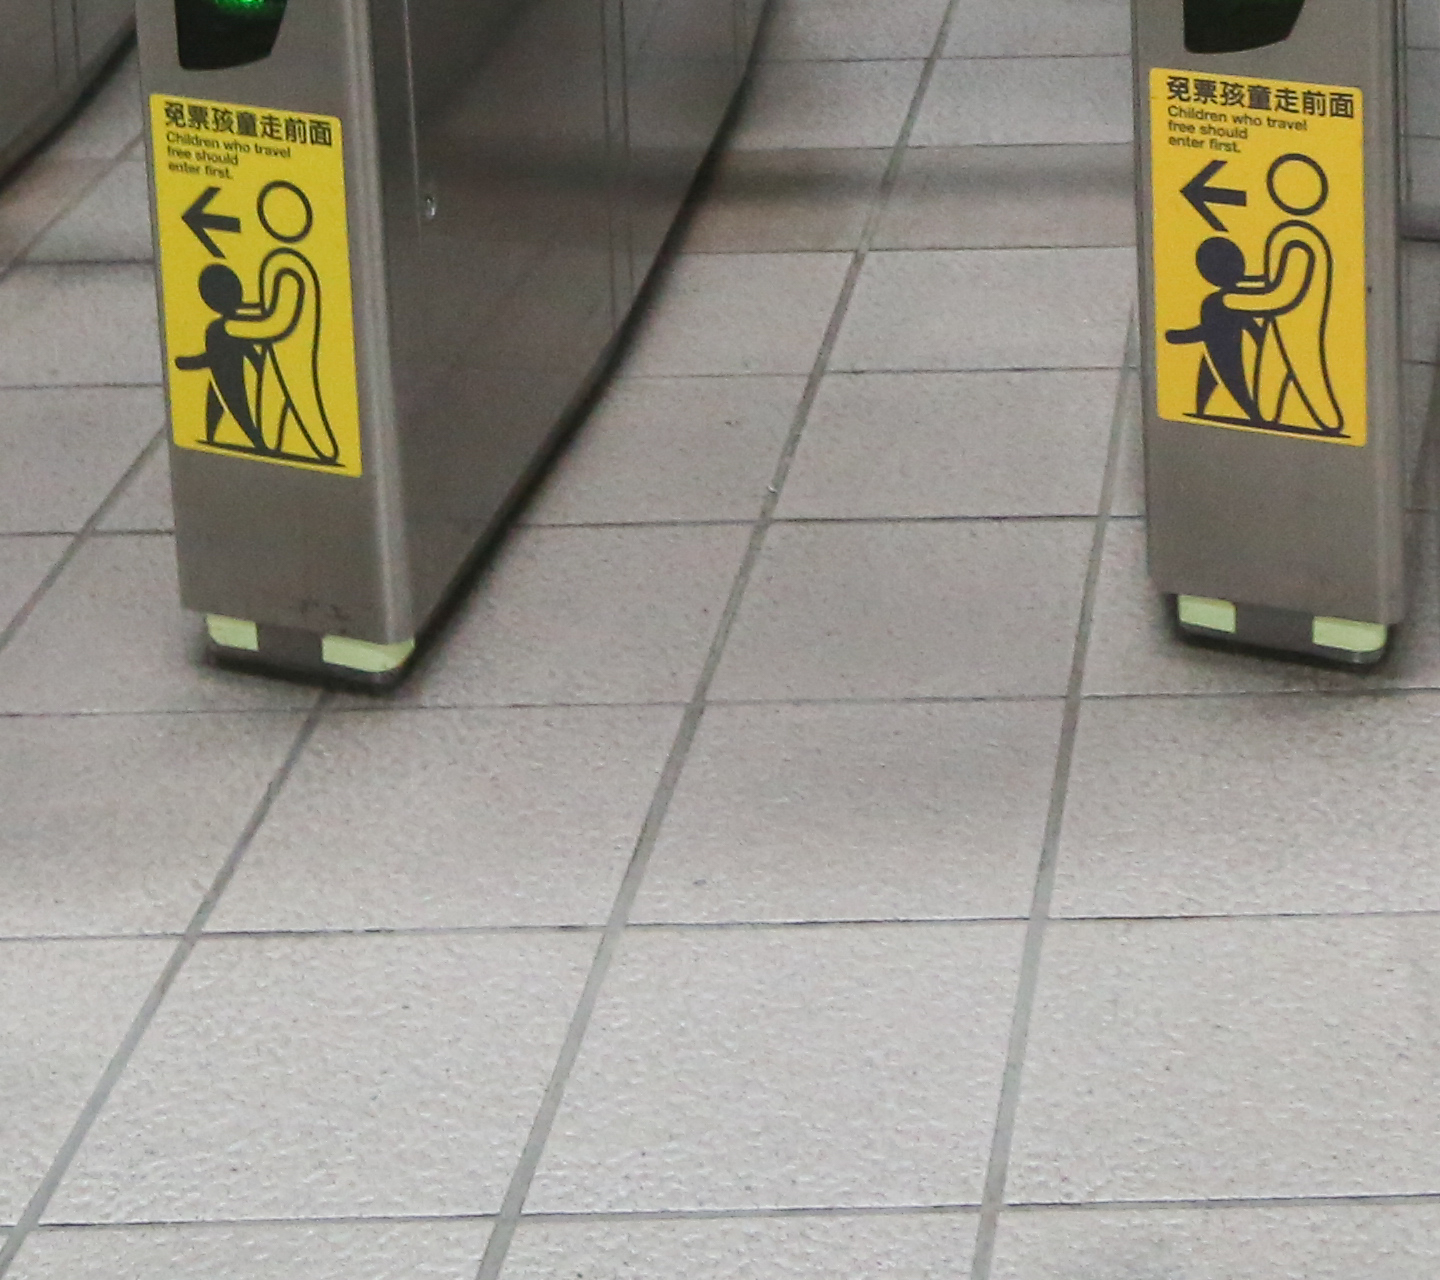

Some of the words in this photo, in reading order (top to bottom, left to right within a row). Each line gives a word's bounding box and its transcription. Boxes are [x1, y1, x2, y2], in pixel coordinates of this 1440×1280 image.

[1166, 76, 1354, 119] 免票孩童走前面
[164, 101, 332, 148] 免票孩童走前面
[1168, 105, 1226, 123] Children
[1232, 114, 1262, 127] who
[1267, 116, 1308, 131] travel
[1168, 120, 1196, 134] free
[1200, 123, 1248, 140] should
[166, 131, 220, 148] Children
[224, 140, 250, 153] who
[255, 143, 291, 158] travel
[1168, 136, 1204, 148] enter
[1209, 137, 1241, 153] first.
[167, 146, 192, 160] free
[195, 149, 238, 167] should
[168, 162, 200, 175] enter
[205, 164, 233, 179] first.
